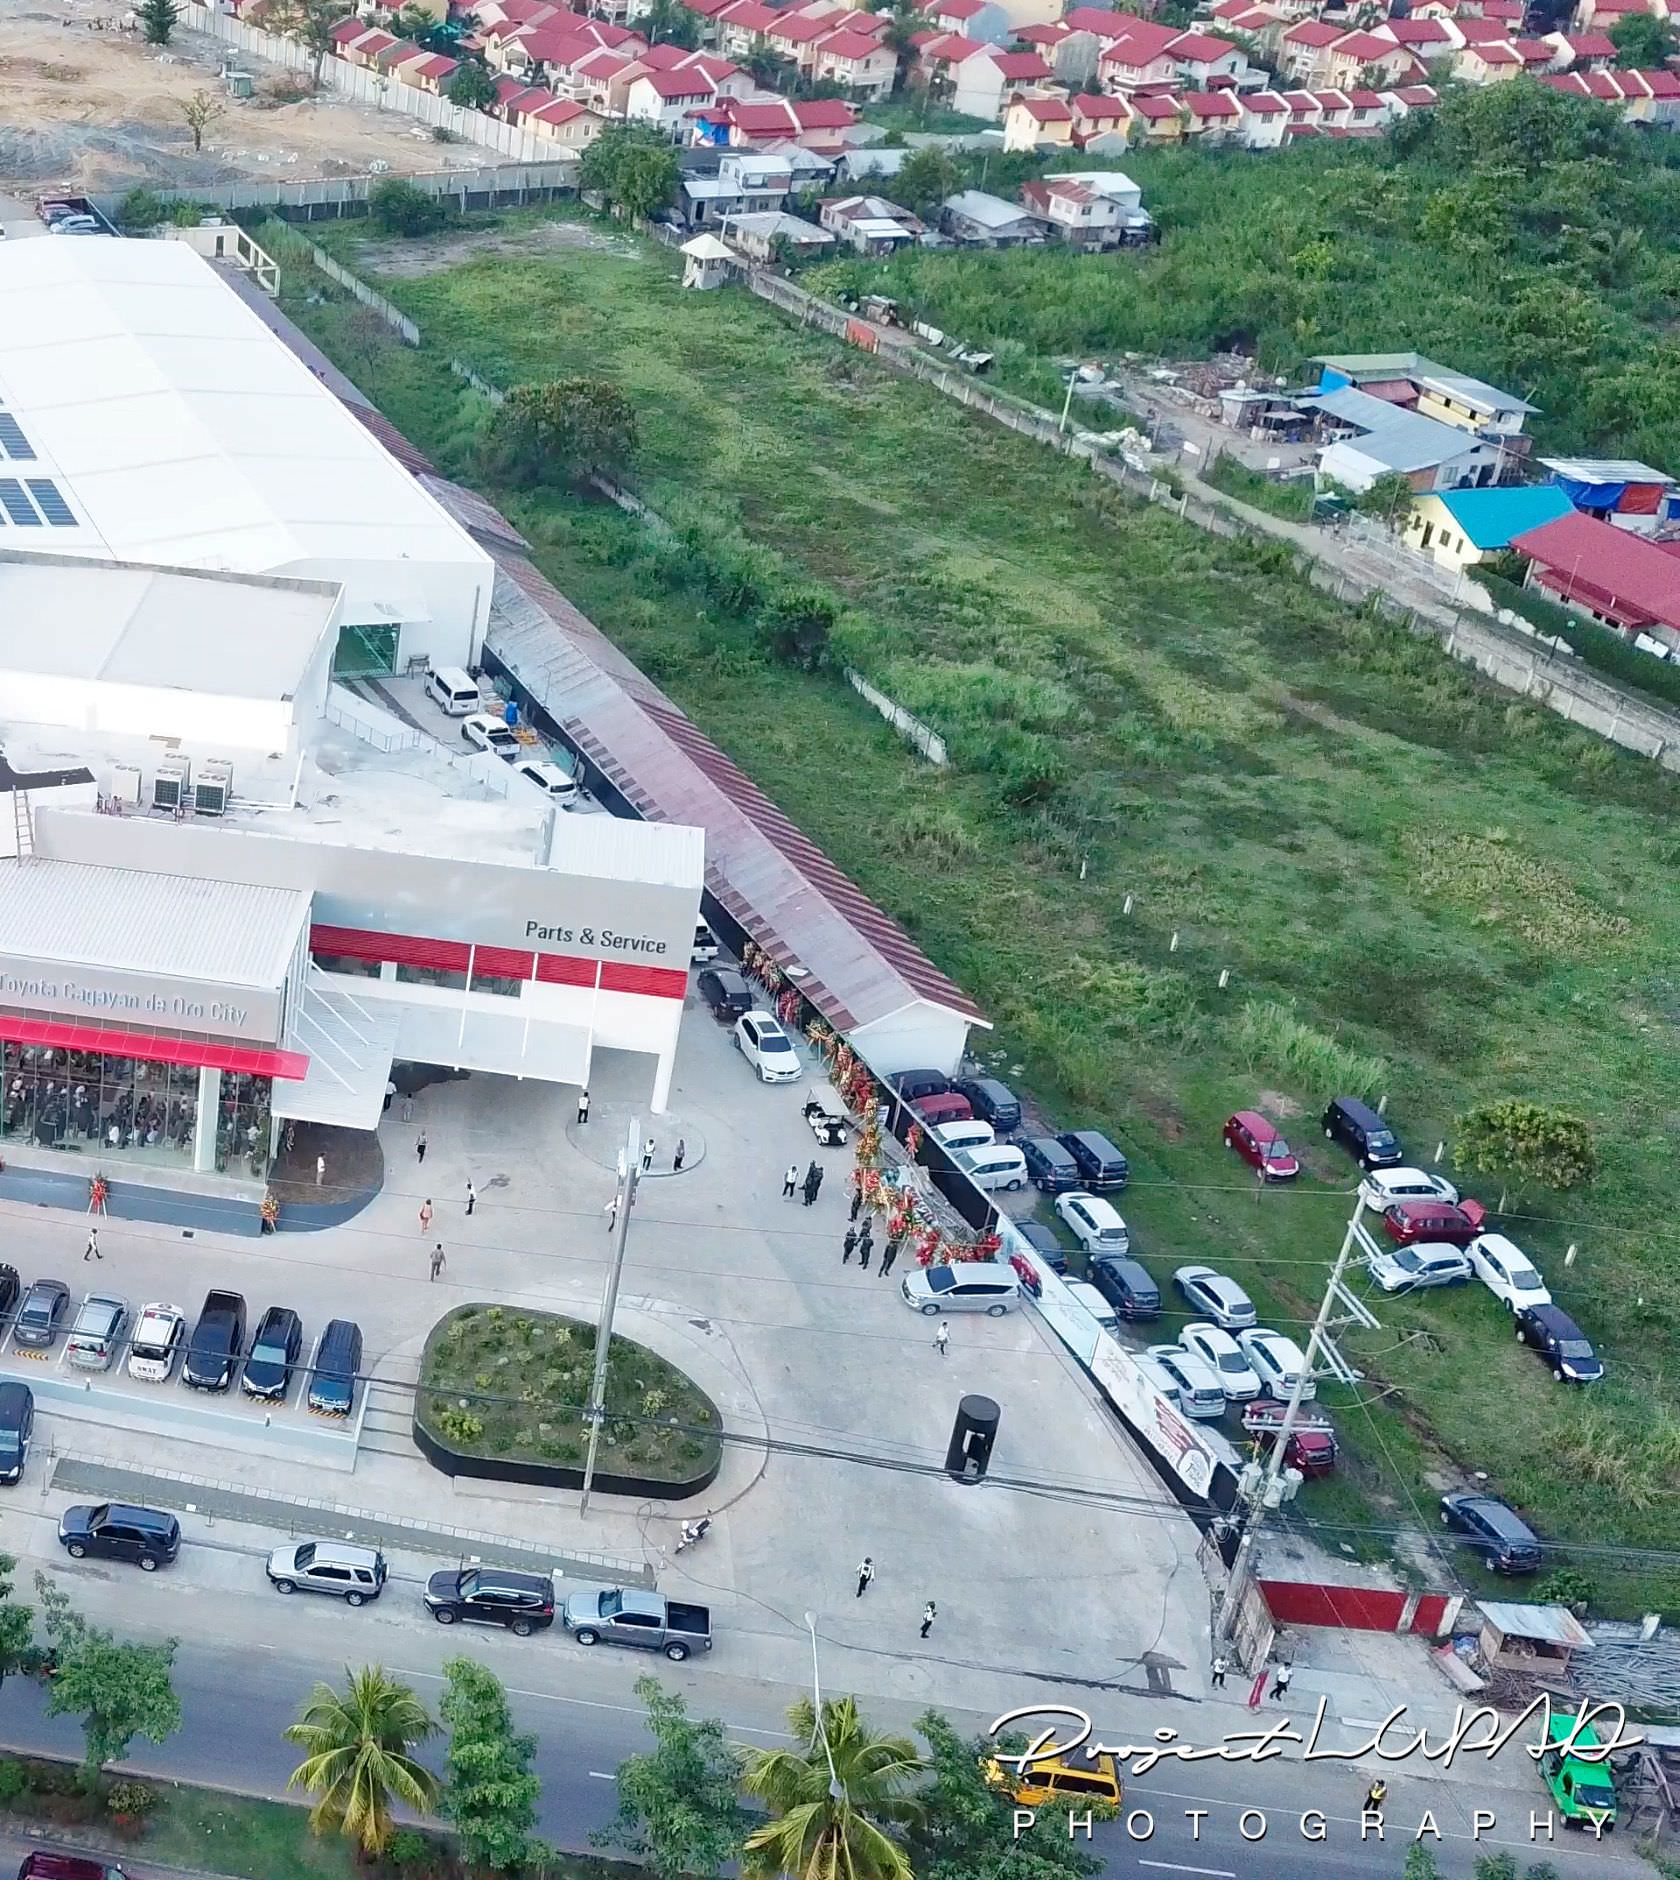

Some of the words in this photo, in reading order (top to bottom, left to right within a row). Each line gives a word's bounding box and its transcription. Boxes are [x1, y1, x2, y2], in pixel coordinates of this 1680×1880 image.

[525, 920, 573, 942] Parts
[579, 927, 595, 945] &
[600, 930, 666, 954] Service
[145, 993, 167, 1013] de
[173, 997, 204, 1018] Oro
[210, 1001, 248, 1027] City
